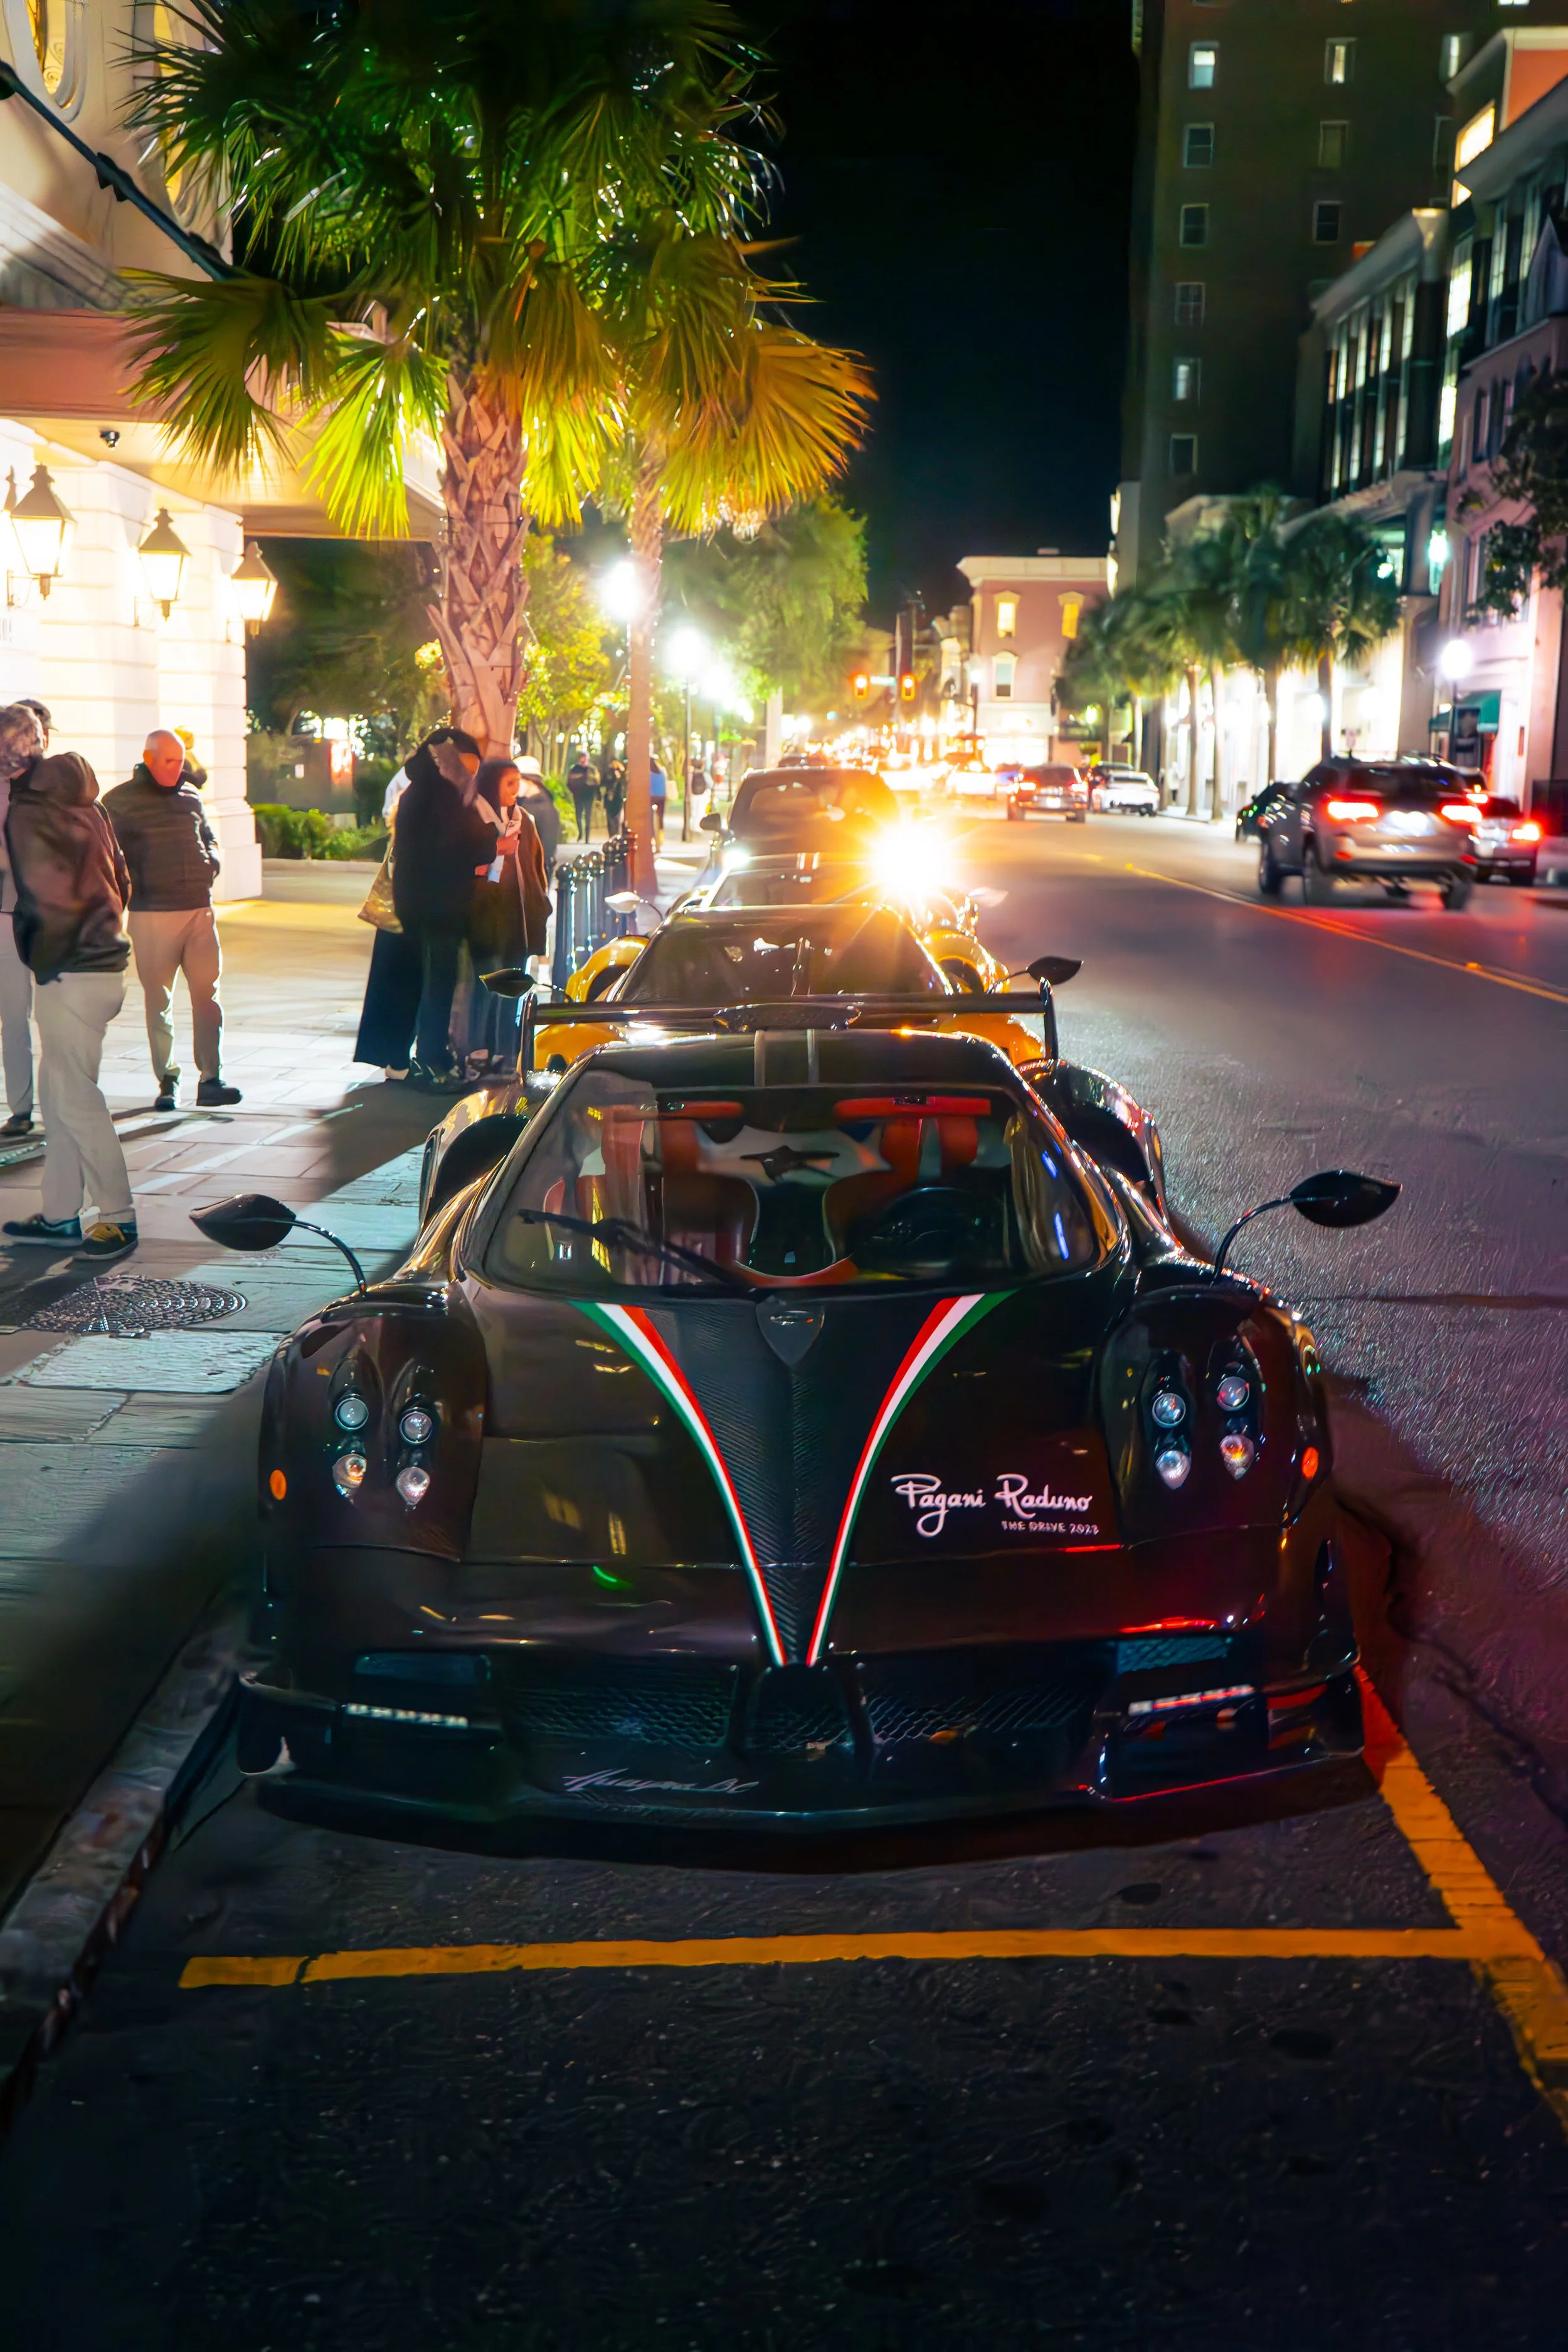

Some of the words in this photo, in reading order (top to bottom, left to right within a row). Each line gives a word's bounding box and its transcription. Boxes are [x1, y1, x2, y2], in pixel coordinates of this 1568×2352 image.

[891, 1474, 987, 1537] Pagani
[994, 1474, 1093, 1519] Raduno
[1001, 1520, 1025, 1531] THE
[1029, 1522, 1066, 1533] DRIVE
